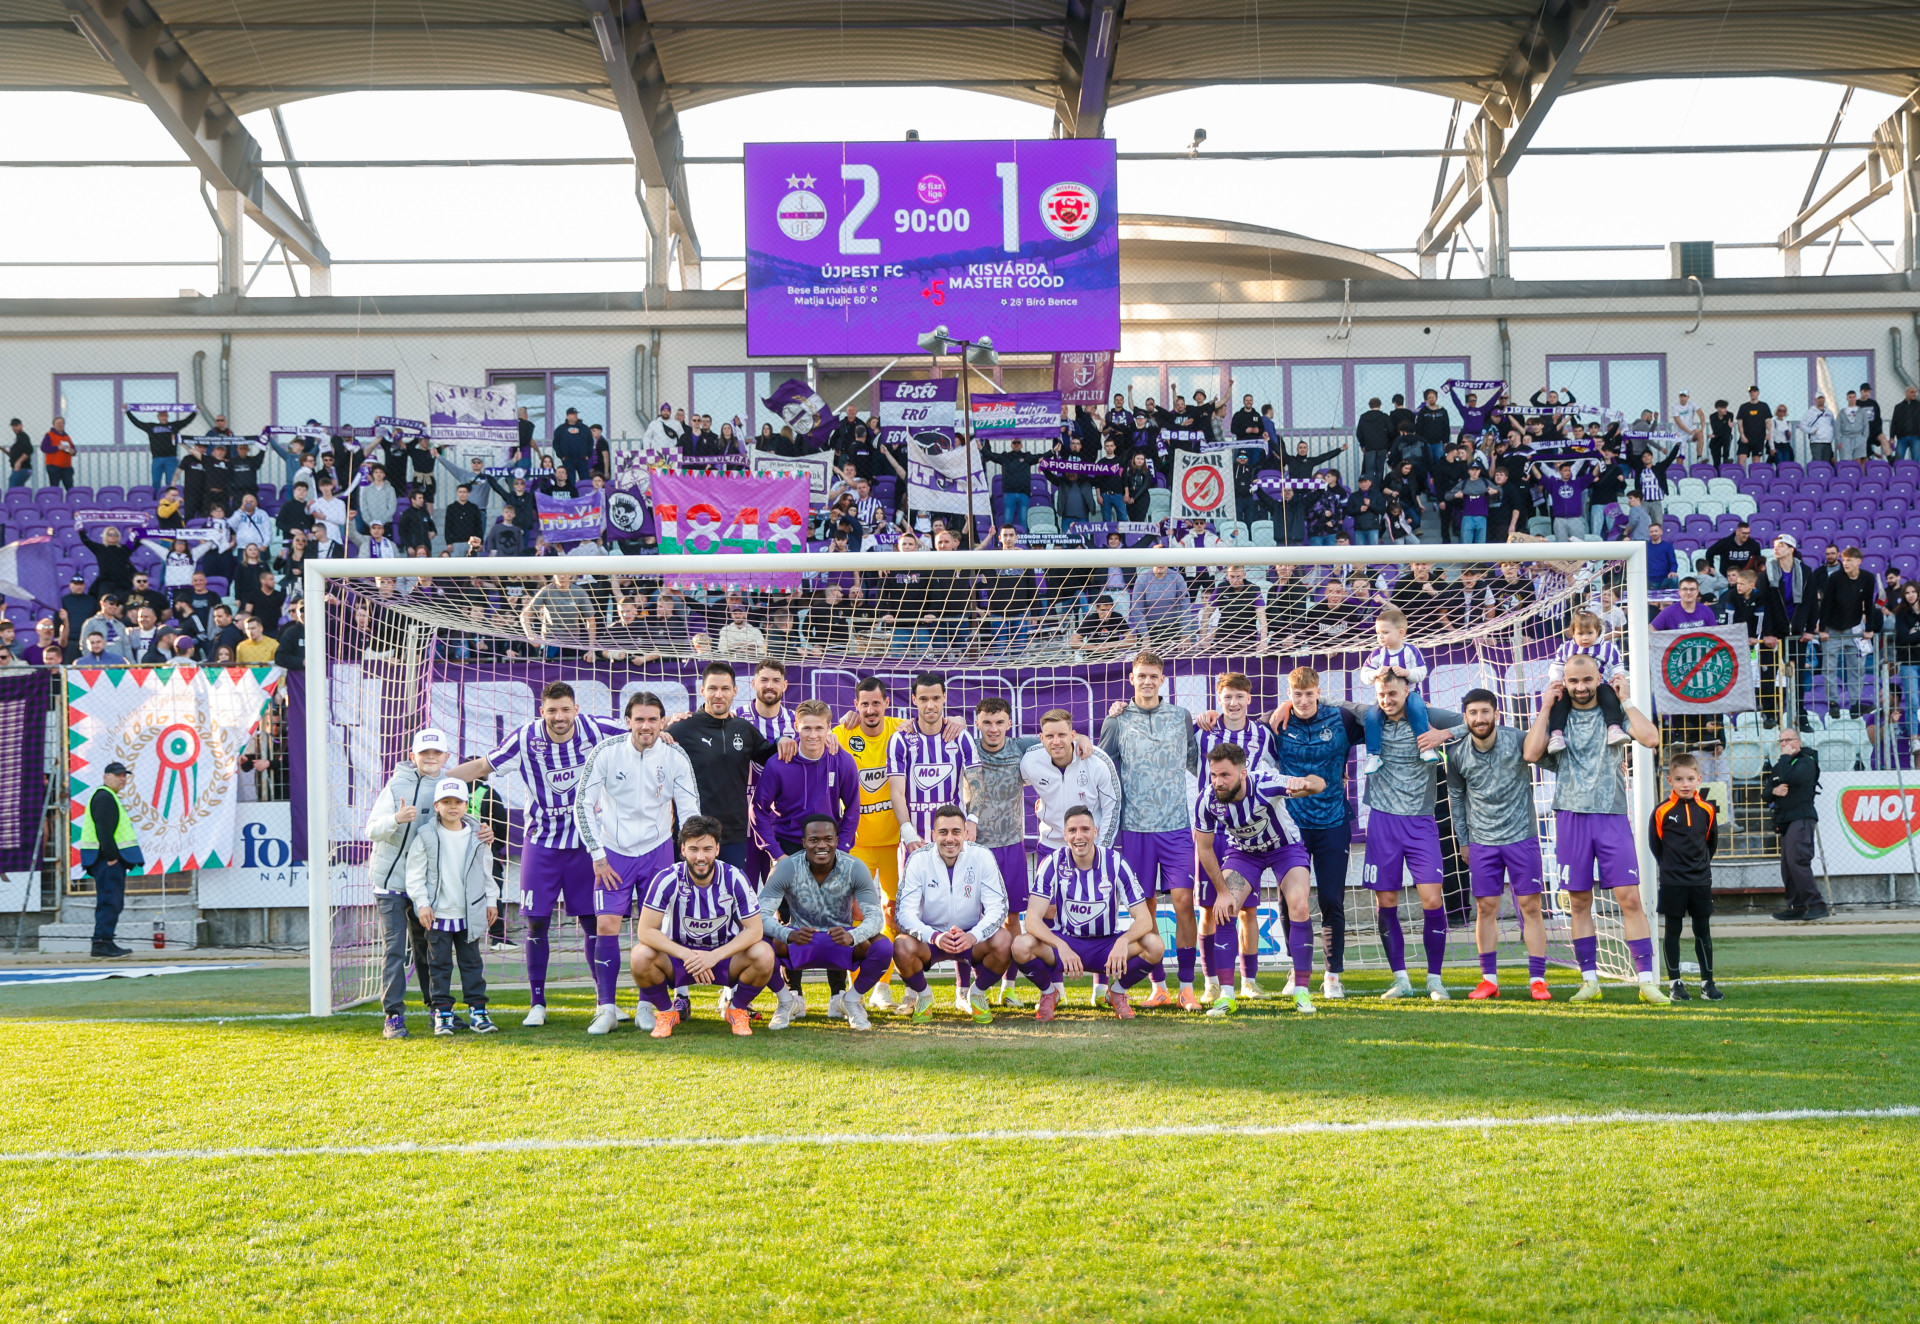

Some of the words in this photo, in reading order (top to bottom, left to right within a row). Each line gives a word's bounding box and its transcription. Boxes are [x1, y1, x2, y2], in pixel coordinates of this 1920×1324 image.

[928, 190, 942, 199] liga
[838, 164, 881, 255] 2
[995, 162, 1020, 253] 1
[894, 208, 970, 233] 90:00
[821, 263, 879, 278] ÚJPEST
[883, 265, 903, 278] FC
[969, 260, 1048, 276] KISVÁRDA
[949, 277, 1013, 289] MASTER
[1017, 276, 1064, 288] GOOD
[787, 286, 811, 294] Bese
[813, 285, 857, 294] Barnabás
[859, 285, 868, 294] 6'
[921, 280, 945, 306] +5
[794, 296, 824, 307] Matija
[853, 296, 868, 304] 60'
[1048, 298, 1078, 306] Bence
[895, 382, 938, 399] ÉPSÉG
[901, 405, 932, 420] ERŐ
[881, 431, 909, 443] EGY
[683, 456, 706, 464] PEST
[1049, 461, 1109, 472] FIORENTINA
[1181, 455, 1223, 469] SZAR
[485, 467, 510, 478] ajrá
[655, 503, 803, 554] 1848
[1074, 522, 1109, 533] HAJRÁ
[552, 770, 575, 783] MOL
[864, 771, 885, 781] MOL
[918, 768, 940, 777] MOL
[546, 805, 574, 816] TiPP
[859, 800, 893, 814] TiPPM
[910, 799, 955, 812] TiPPMX
[1852, 795, 1916, 822] MOL
[261, 872, 348, 880] NATA
[1364, 864, 1377, 884] 88
[1070, 903, 1091, 915] MOL
[689, 920, 713, 928] MOL
